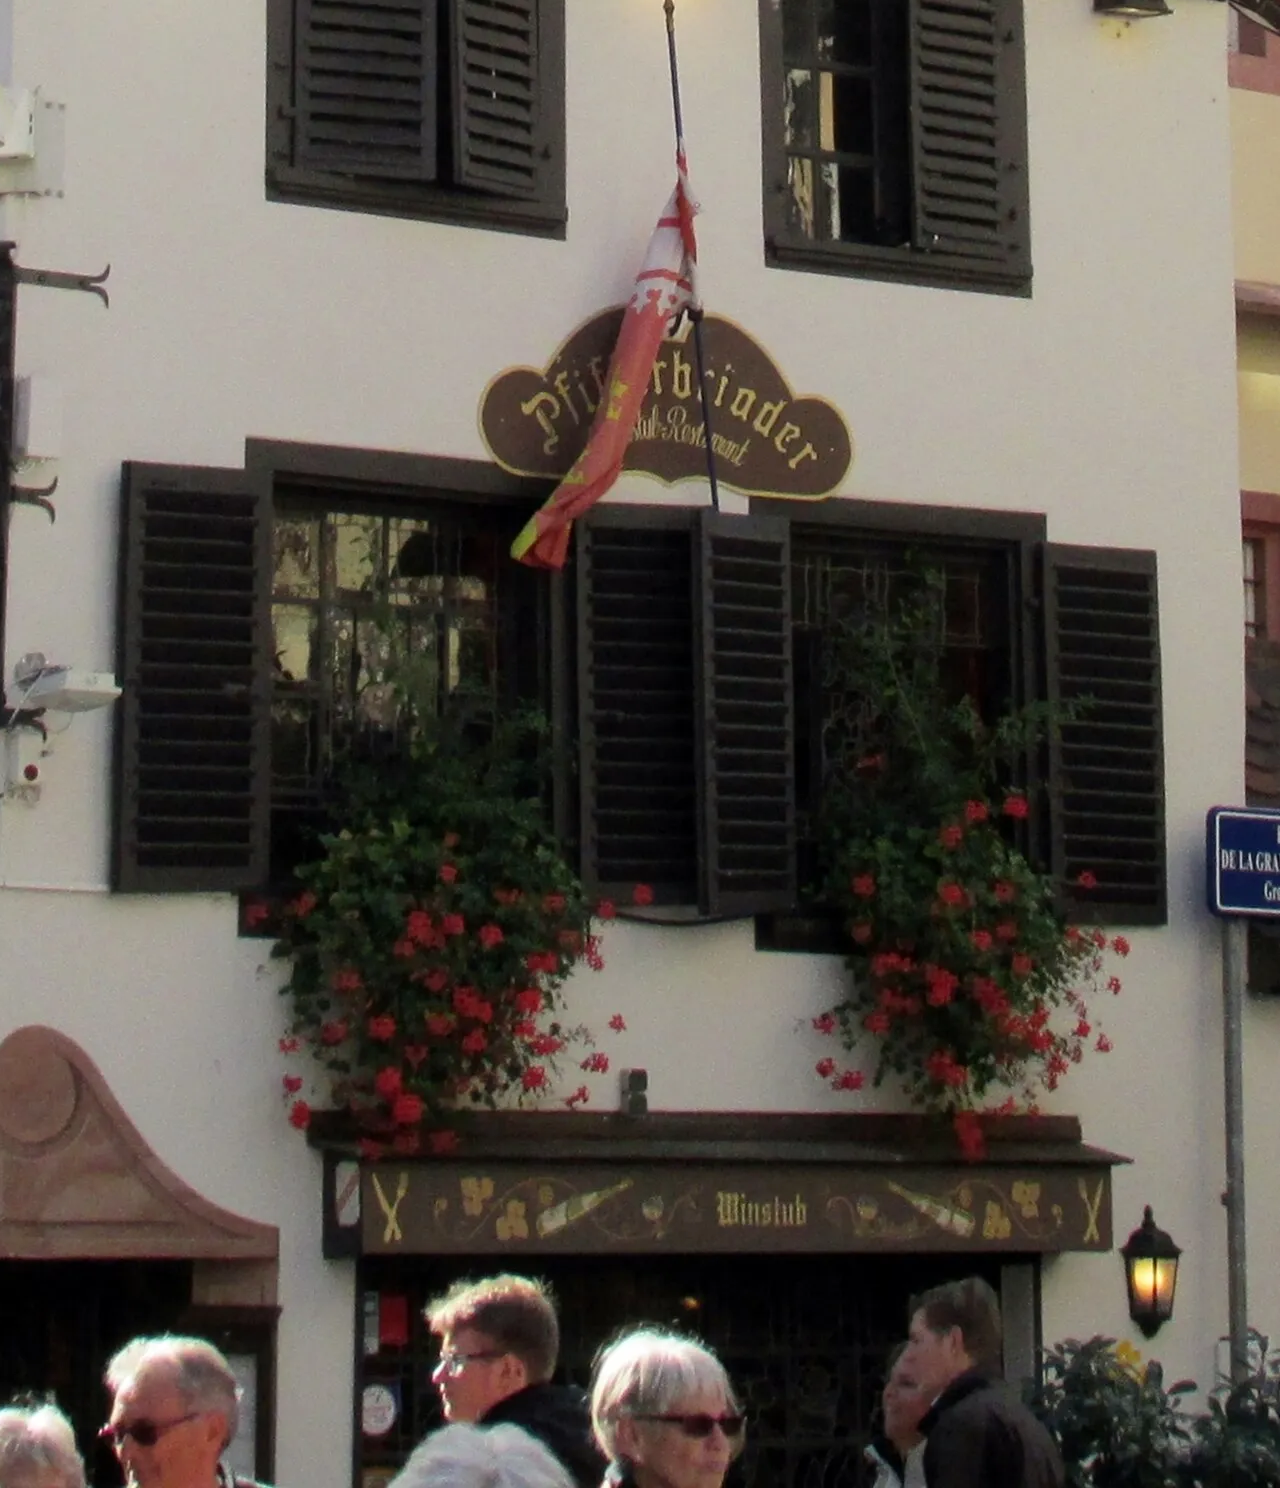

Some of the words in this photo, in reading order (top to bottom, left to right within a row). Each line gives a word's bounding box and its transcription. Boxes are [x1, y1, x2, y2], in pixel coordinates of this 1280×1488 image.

[1221, 849, 1237, 870] DE
[1239, 850, 1253, 871] LA
[717, 1191, 807, 1227] Winstub
